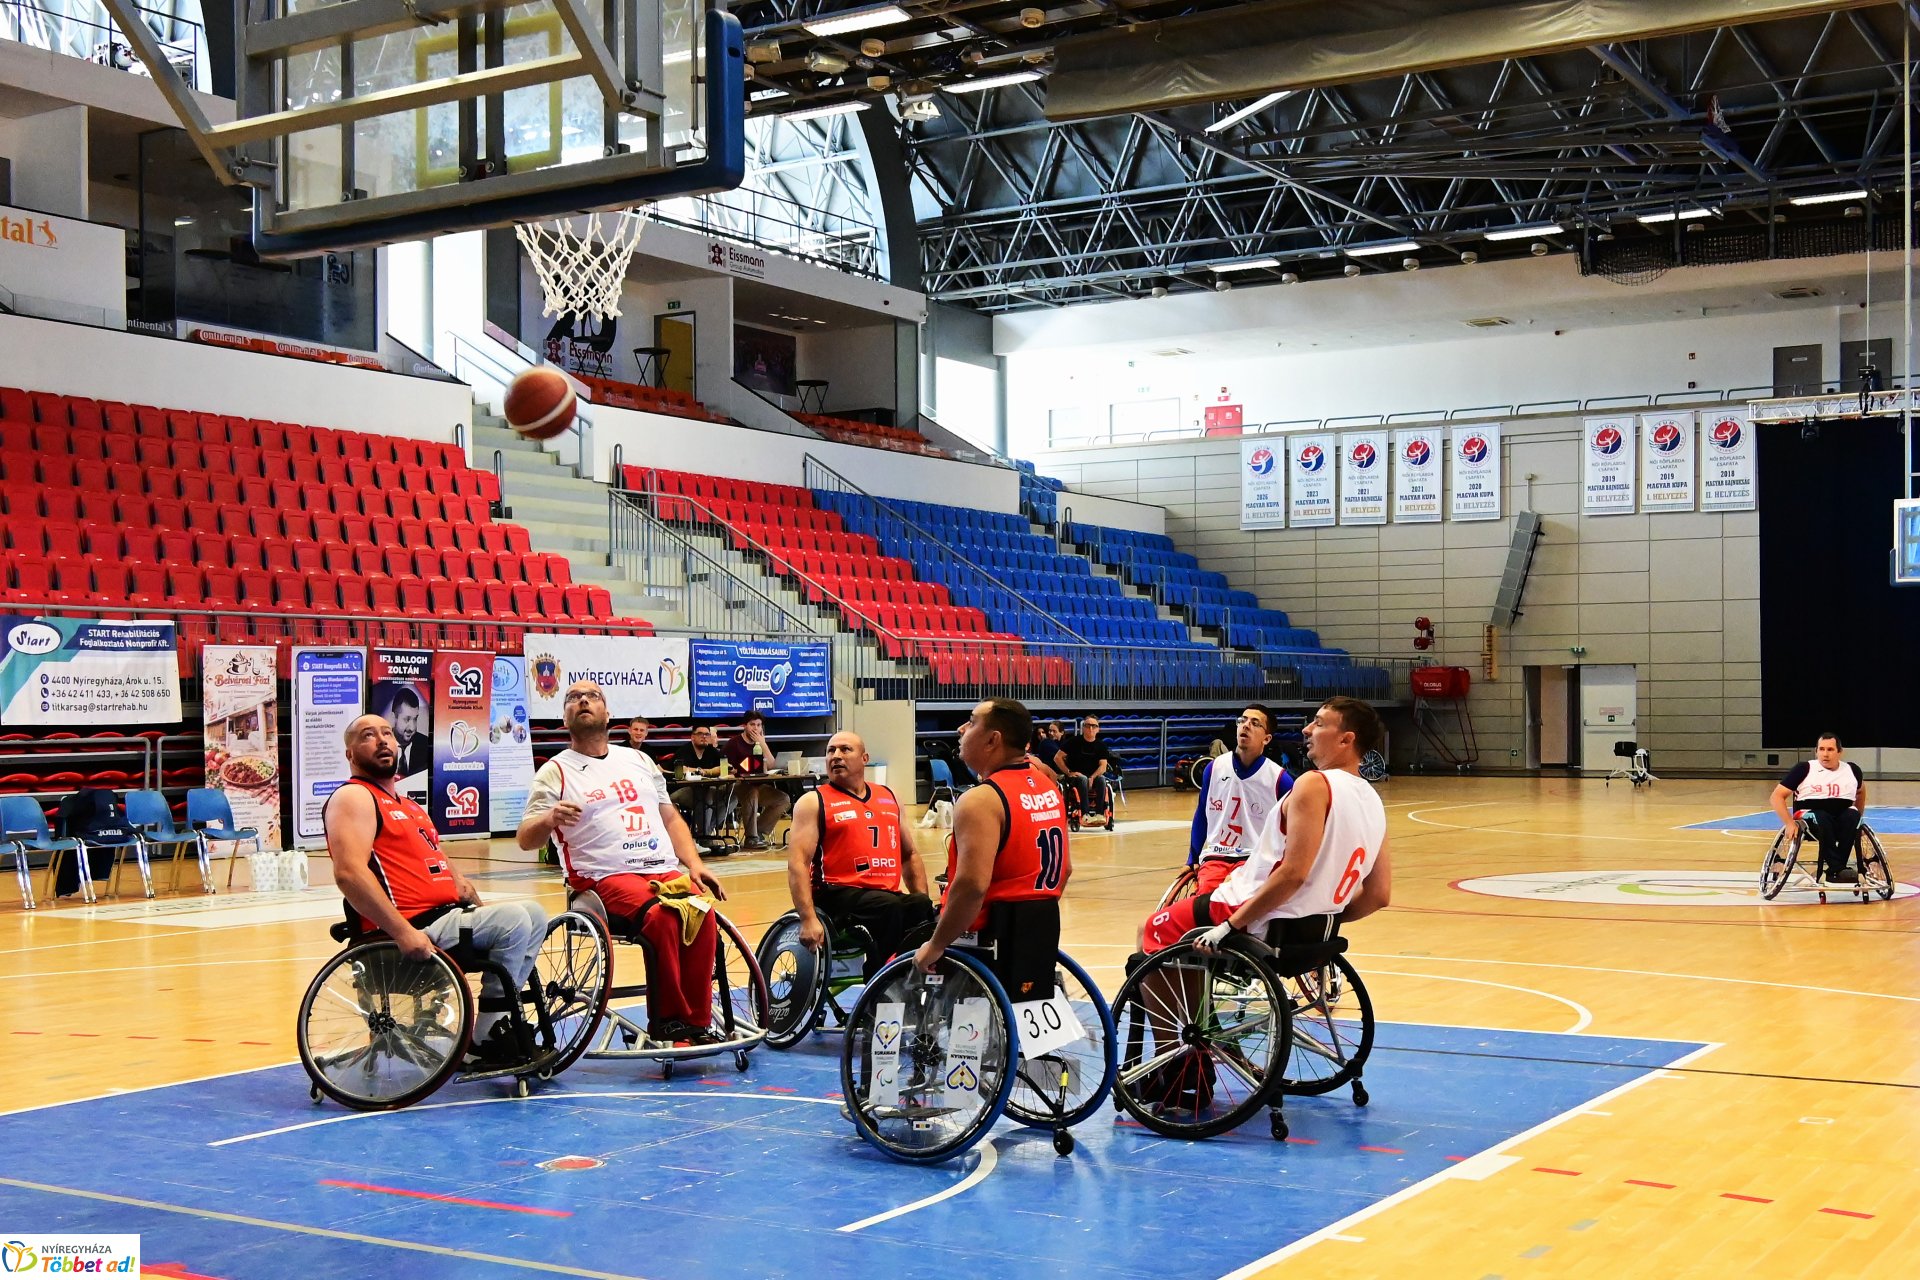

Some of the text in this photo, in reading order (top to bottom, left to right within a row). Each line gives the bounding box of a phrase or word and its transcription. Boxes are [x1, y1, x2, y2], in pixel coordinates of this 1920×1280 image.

[729, 247, 764, 268] Eissmann
[1601, 475, 1616, 483] 2019
[1720, 470, 1735, 478] 2018
[1587, 484, 1605, 492] MAGYAR
[1646, 482, 1671, 490] MAGYAR
[16, 630, 51, 647] Start
[88, 629, 160, 639] START Rehabilitációs
[79, 638, 125, 648] Foglalkoztató
[125, 639, 157, 649] Nonprofit
[379, 655, 428, 665] IFJ. BALOGH
[387, 664, 420, 675] ZOLTÁN
[735, 666, 770, 685] Oplus
[51, 676, 71, 685] 4400
[73, 676, 125, 689] Nyíregyháza,
[125, 675, 142, 685] Árok
[153, 676, 164, 685] 15.
[568, 668, 653, 686] NYÍREGYHÁZA
[51, 689, 66, 698] +36
[67, 689, 78, 698] 42
[79, 689, 94, 698] 411
[96, 689, 113, 699] 433,
[120, 689, 129, 698] 36
[130, 689, 140, 698] 42
[141, 689, 156, 698] 508
[156, 689, 171, 698] 650
[51, 702, 148, 713] titkarsag@startrehab.hu
[609, 778, 638, 804] 18
[1826, 783, 1840, 797] 10
[1019, 789, 1060, 811] SUPER
[1231, 796, 1242, 820] 7
[1030, 809, 1061, 823] FOUNDATION
[622, 841, 648, 850] Oplus
[871, 858, 896, 868] BRD
[1033, 826, 1063, 891] 10
[1332, 847, 1366, 905] 6
[1152, 911, 1170, 926] 6
[1023, 1001, 1062, 1039] 3.0
